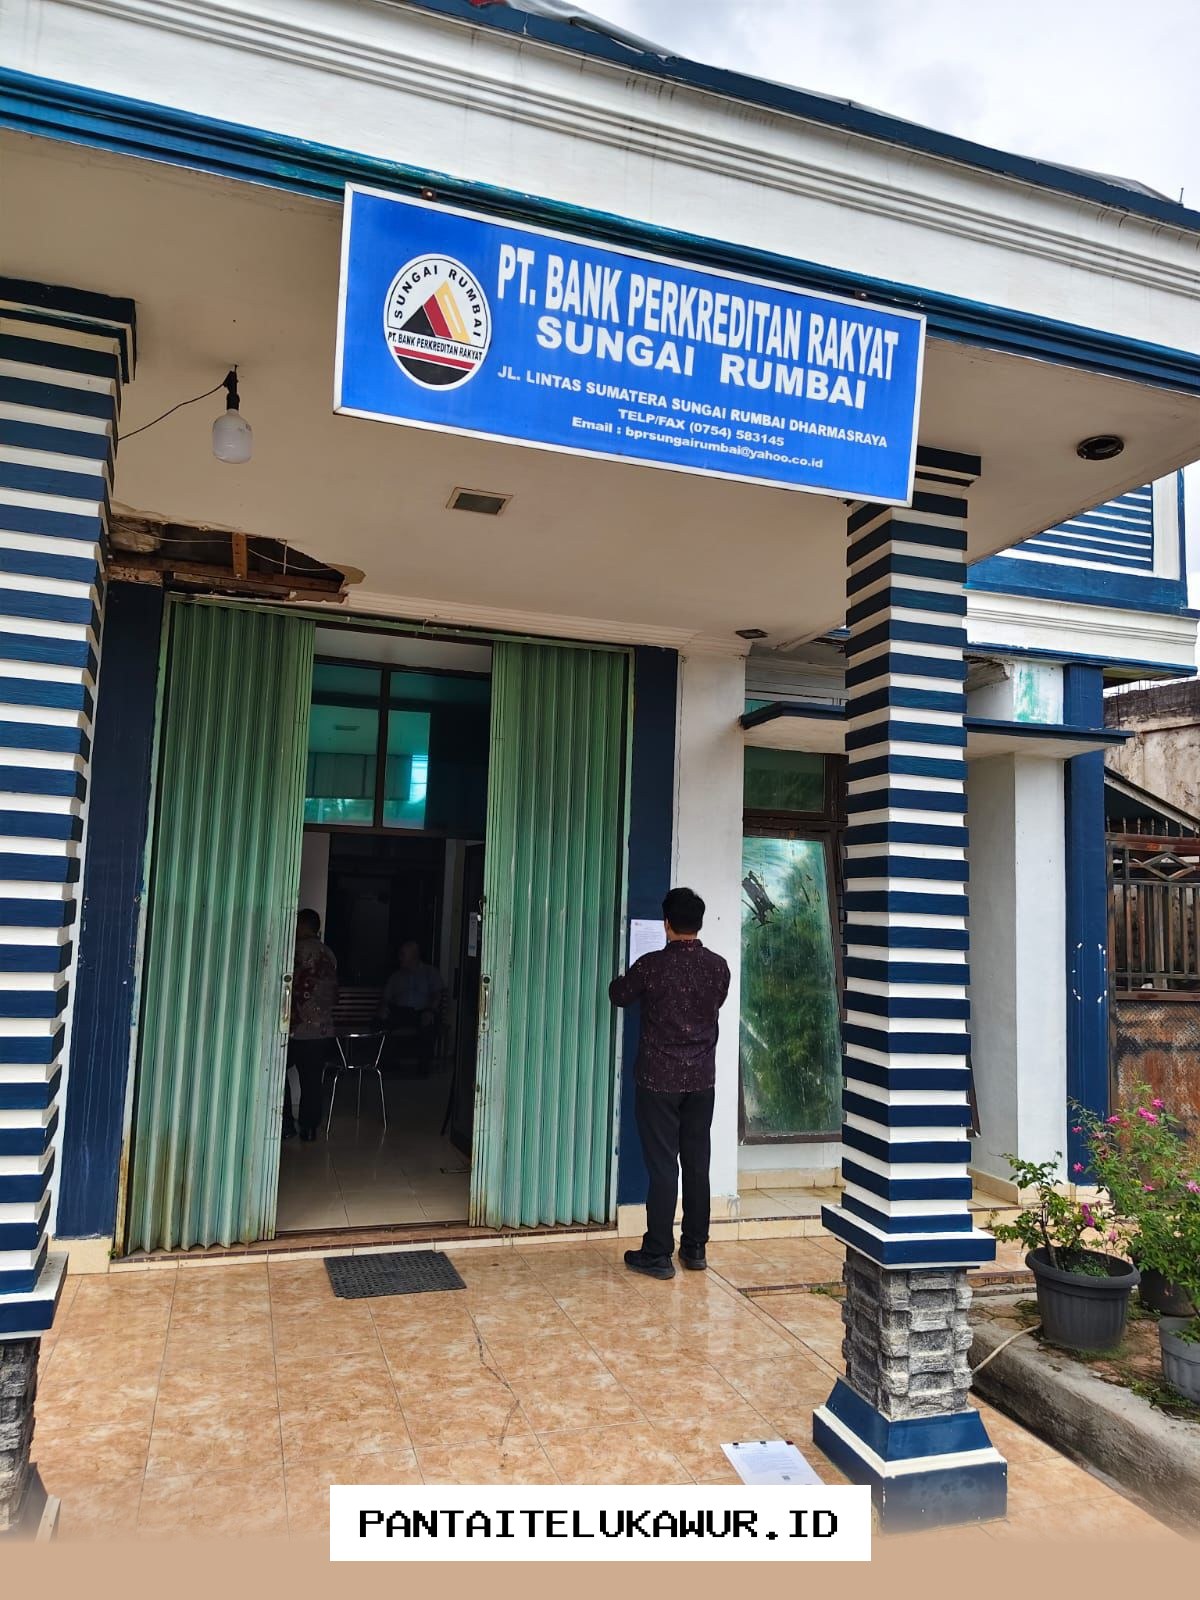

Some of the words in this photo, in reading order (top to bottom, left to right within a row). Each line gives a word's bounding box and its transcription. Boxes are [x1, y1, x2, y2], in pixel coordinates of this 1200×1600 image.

[394, 265, 438, 319] SUNGAI
[448, 268, 482, 337] RUMBAI
[497, 243, 536, 306] PT.
[545, 254, 623, 323] BANK
[627, 273, 802, 361] PERKREDITAN
[807, 312, 899, 381] RAKYAT
[387, 331, 397, 342] PT.
[398, 333, 415, 346] BANK
[416, 337, 459, 356] PERKREDITAN
[459, 347, 483, 361] RAKYAT
[536, 315, 695, 376] SUNGAI
[719, 353, 867, 410] RUMBAI
[497, 365, 521, 381] JL.
[526, 369, 582, 392] LINTAS
[586, 381, 667, 408] SUMATERA
[671, 398, 726, 419] SUNGAI
[730, 408, 785, 430] RUMBAI
[789, 419, 888, 448] DHARMASRAYA
[572, 416, 613, 433] Email
[625, 426, 824, 469] bprsungairumbai@yahoo.co.id
[618, 408, 685, 430] TELP/FAX
[689, 421, 732, 440] (0754)
[736, 429, 785, 447] 583145
